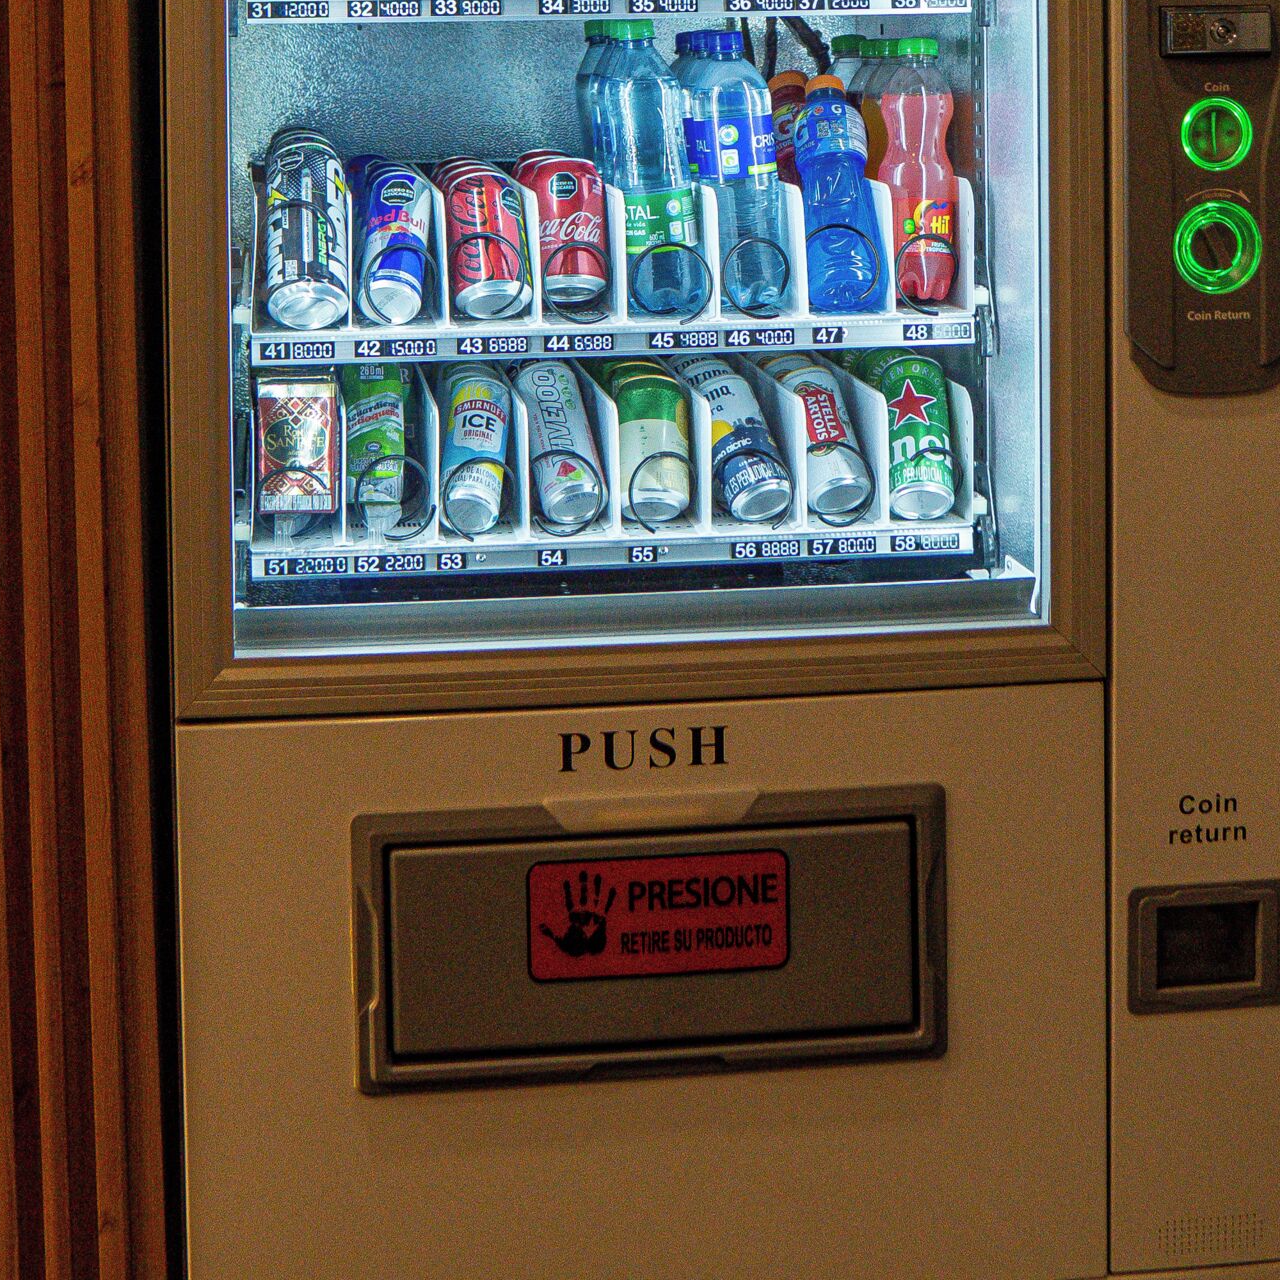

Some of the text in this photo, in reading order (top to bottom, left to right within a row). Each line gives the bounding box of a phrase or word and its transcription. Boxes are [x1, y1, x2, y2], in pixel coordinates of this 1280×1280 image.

[252, 2, 272, 18] 31
[350, 2, 372, 16] 32
[434, 0, 456, 14] 33
[1204, 81, 1231, 92] Coin
[831, 104, 842, 115] G
[398, 210, 426, 234] Bull
[317, 215, 328, 266] ENERGY
[1187, 309, 1250, 321] Coin Return
[651, 332, 674, 348] 45
[728, 330, 750, 346] 46
[816, 328, 838, 342] 47
[906, 325, 928, 340] 48
[264, 344, 288, 358] 41
[357, 342, 381, 356] 42
[460, 338, 483, 354] 43
[546, 336, 570, 350] 44
[456, 401, 506, 420] SMIRNOFF
[817, 394, 840, 439] STELLA
[462, 414, 497, 433] ICE
[805, 396, 829, 442] ARTOIS
[463, 429, 493, 442] ORIGINAL
[735, 542, 756, 558] 56
[812, 539, 834, 554] 57
[894, 536, 916, 550] 58
[440, 554, 463, 570] 53
[540, 550, 564, 566] 54
[632, 546, 654, 562] 55
[268, 560, 288, 574] 51
[357, 556, 380, 572] 52
[558, 725, 729, 773] PUSH
[1179, 793, 1238, 815] Coin
[1169, 824, 1248, 845] return
[627, 873, 779, 913] PRESIONE
[620, 924, 773, 955] RETIRE SU PRODUCTO
